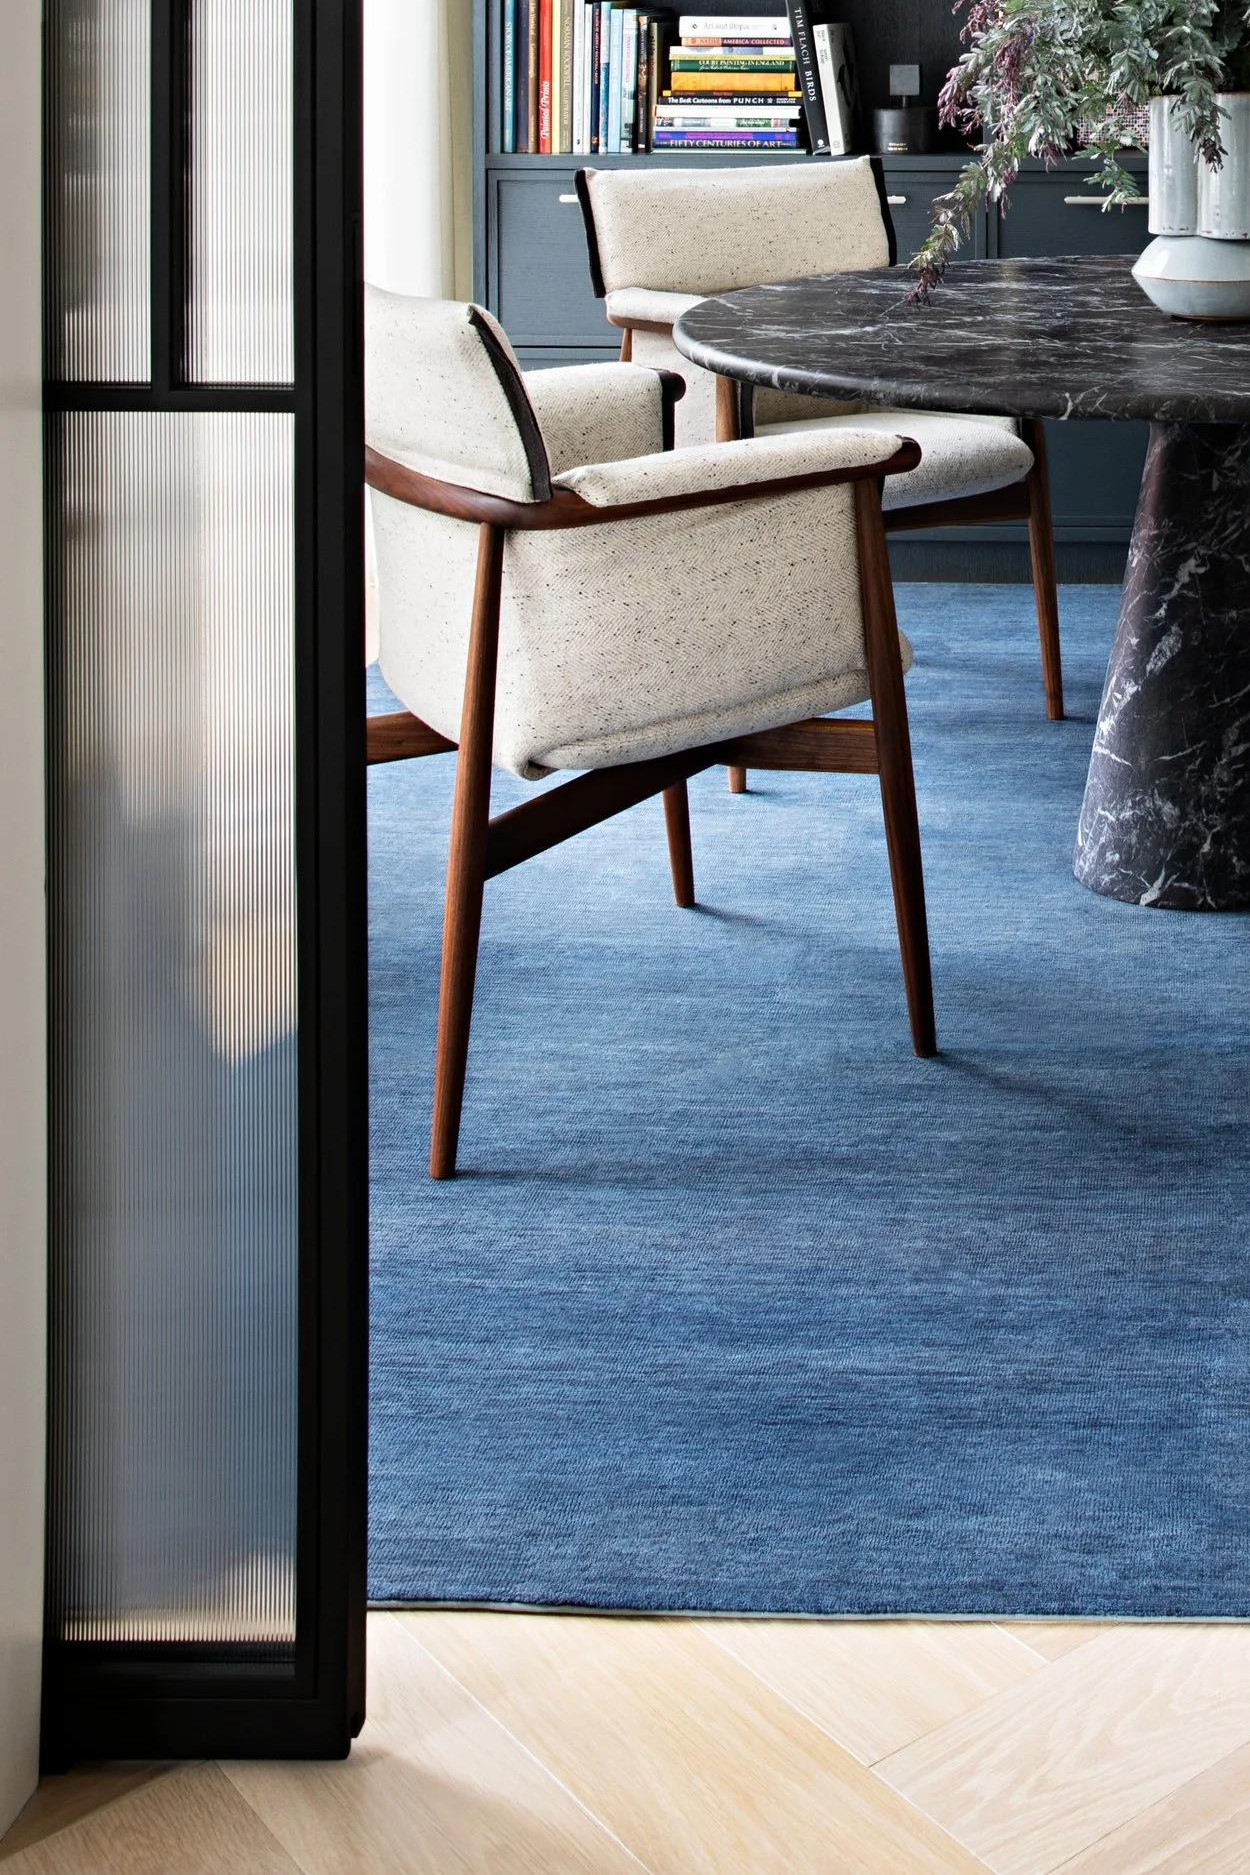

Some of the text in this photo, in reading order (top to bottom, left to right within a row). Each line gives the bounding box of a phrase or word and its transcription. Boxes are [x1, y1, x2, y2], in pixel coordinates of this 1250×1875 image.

[794, 7, 816, 102] TIM FLACH BIRDS
